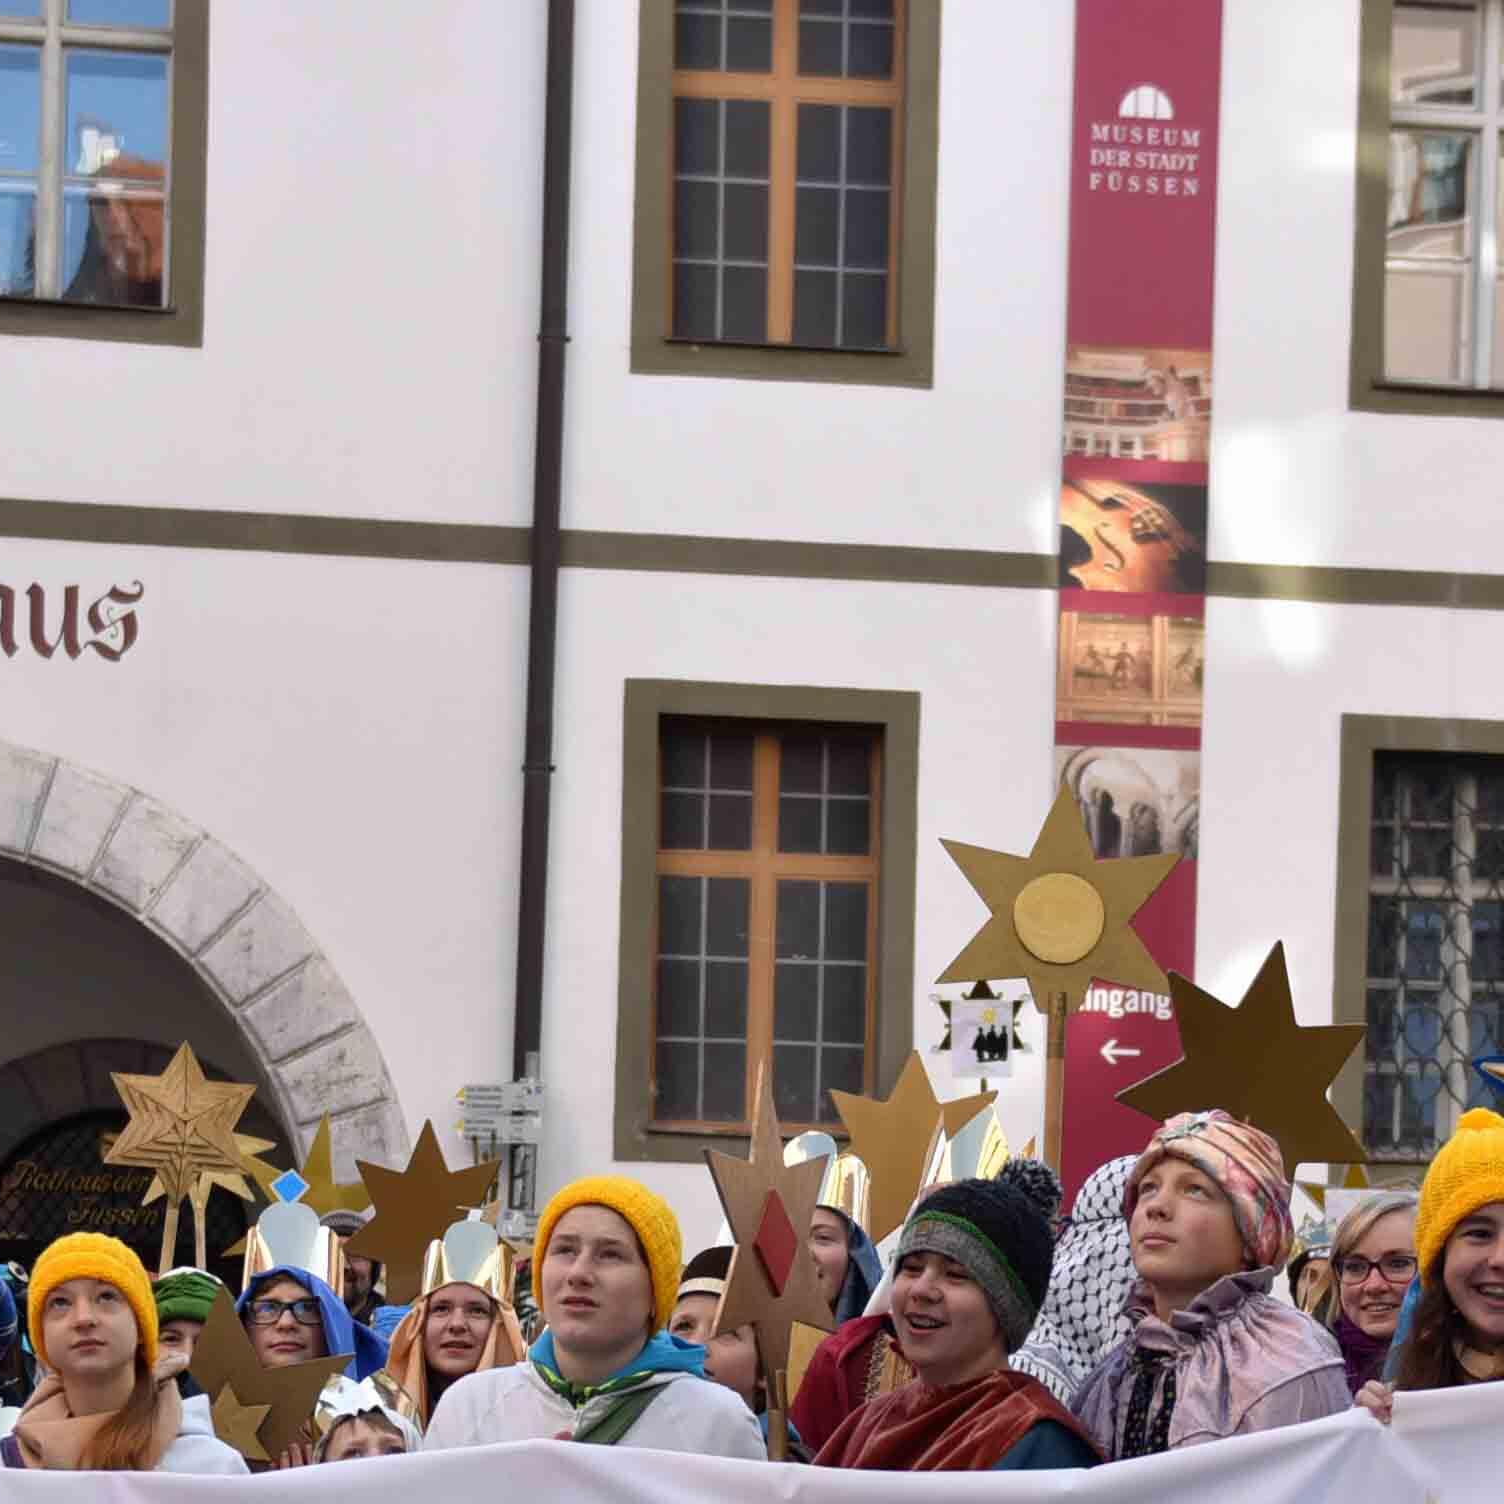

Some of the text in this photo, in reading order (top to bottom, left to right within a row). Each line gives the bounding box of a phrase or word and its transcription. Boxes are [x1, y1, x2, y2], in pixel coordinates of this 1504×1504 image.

[1091, 123, 1200, 147] MUSEUM
[1090, 148, 1199, 172] DER STADT
[1079, 983, 1173, 1020] ingang
[15, 1160, 110, 1193] Rathaus
